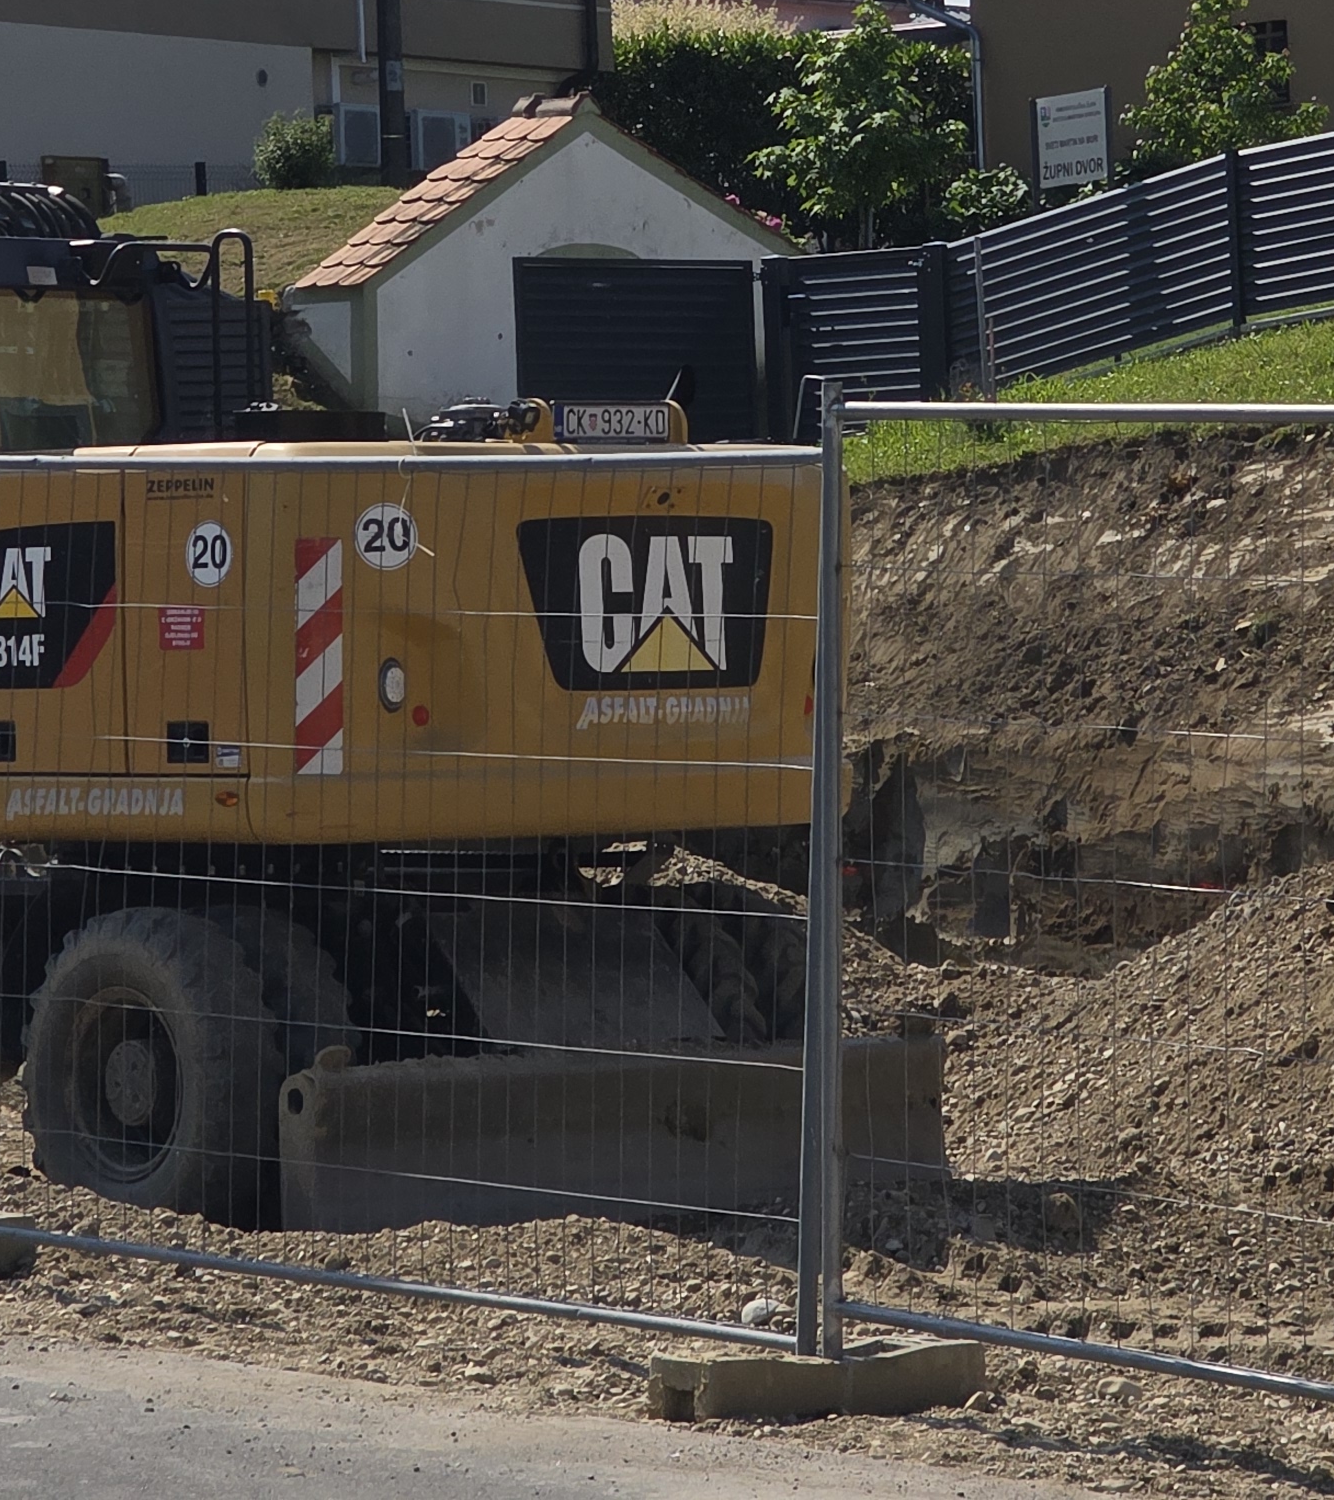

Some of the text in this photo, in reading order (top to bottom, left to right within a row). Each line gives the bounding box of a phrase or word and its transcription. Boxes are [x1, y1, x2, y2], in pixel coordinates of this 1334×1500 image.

[1043, 157, 1104, 180] ŽUPNI DVOR
[566, 408, 587, 435] CK
[147, 478, 214, 493] ZEPPELIN
[362, 517, 410, 553] 20
[192, 535, 226, 569] 20
[579, 534, 733, 672] CAT
